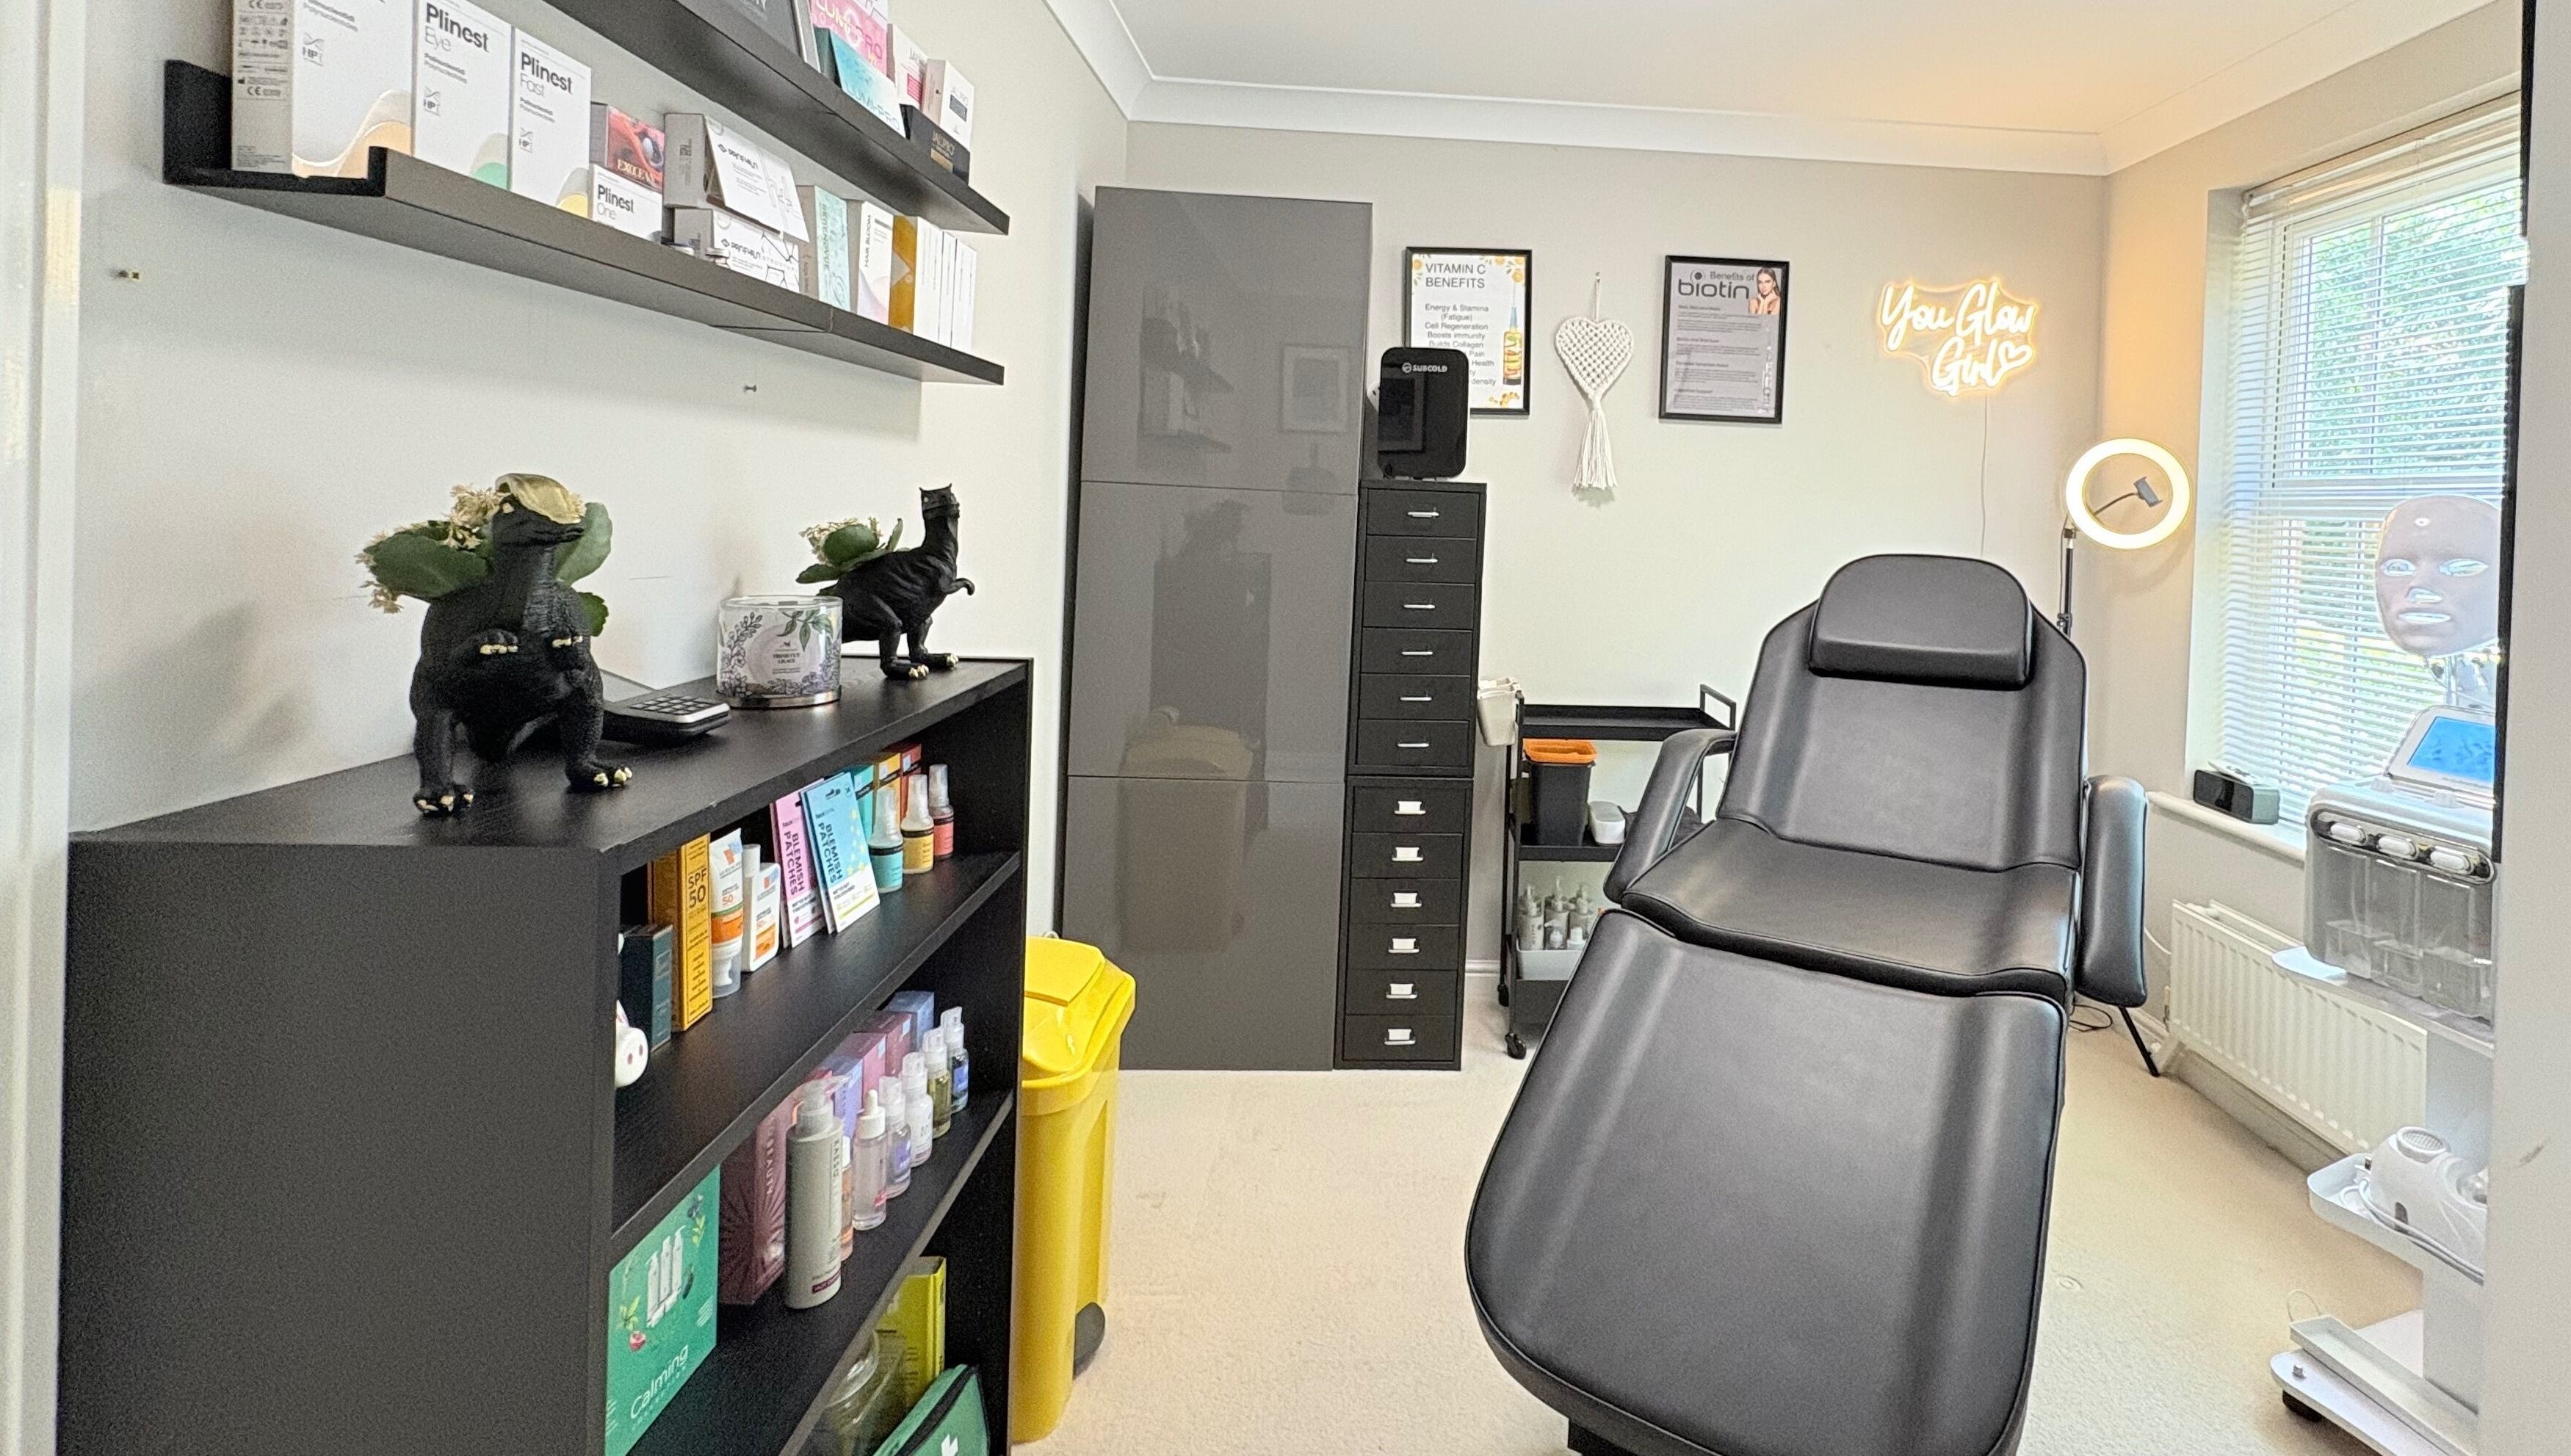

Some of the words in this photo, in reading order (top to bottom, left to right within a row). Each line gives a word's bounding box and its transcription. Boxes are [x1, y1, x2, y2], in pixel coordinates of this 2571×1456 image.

[424, 26, 452, 51] Eye
[425, 2, 490, 53] Plinest
[520, 73, 545, 98] Fast
[521, 51, 574, 95] Plinest
[596, 202, 618, 220] One
[597, 184, 634, 214] Plinest
[1425, 263, 1474, 275] VITAMIN
[1477, 264, 1486, 275] C
[1710, 271, 1744, 281] Benefits
[1746, 272, 1755, 281] of
[1425, 277, 1486, 289] BENEFITS
[1678, 273, 1749, 300] biotin
[1425, 303, 1450, 313] Energy
[1460, 304, 1489, 312] Stamina
[1441, 314, 1472, 322] (Fatigue)
[1881, 285, 1954, 351] You
[1956, 281, 2036, 347] Glow
[1441, 322, 1489, 330] Regeneration
[1454, 333, 1486, 341] immunity
[1453, 341, 1484, 349] Collagen
[1412, 364, 1447, 373] SUBCOLD
[1931, 336, 2003, 396] Girl
[1471, 377, 1497, 387] density
[784, 831, 798, 896] PATCHES
[792, 833, 805, 892] BLEMISH
[818, 822, 836, 884] PATCHES
[825, 823, 843, 880] BLEMISH
[688, 867, 706, 889] SPF
[688, 884, 706, 909] 50
[629, 1344, 690, 1420] Calming
